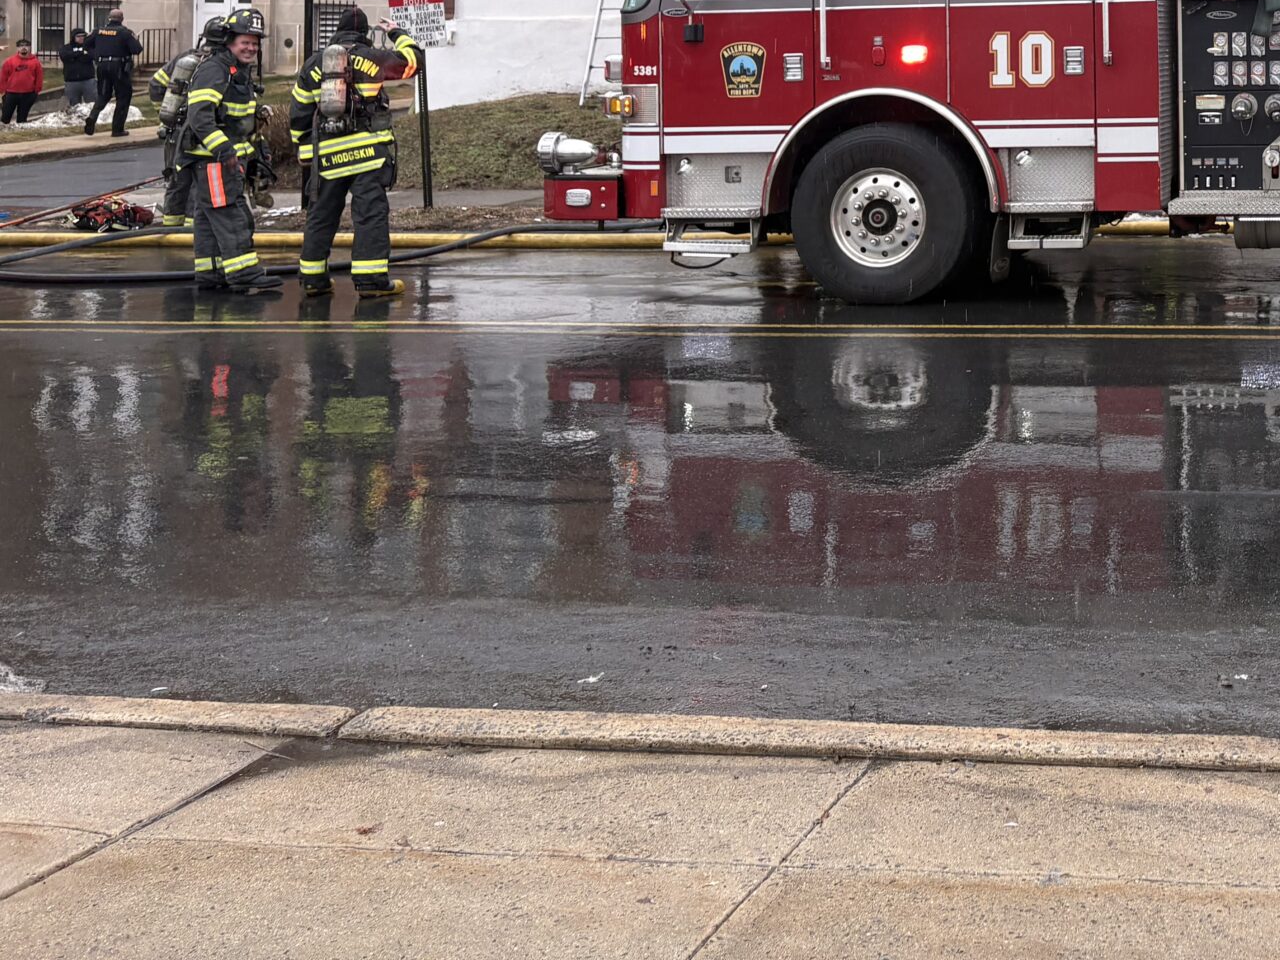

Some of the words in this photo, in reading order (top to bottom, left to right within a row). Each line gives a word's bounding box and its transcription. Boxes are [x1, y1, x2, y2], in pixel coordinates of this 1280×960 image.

[413, 4, 429, 12] TIRES
[391, 13, 412, 21] CHAINS
[416, 10, 443, 20] REQUIRED
[252, 17, 262, 29] 11
[410, 18, 440, 27] PARKING
[415, 25, 445, 34] EMERGENCY
[723, 44, 764, 58] ALLENTOWN
[988, 30, 1055, 88] 10
[633, 65, 657, 76] 5381
[321, 157, 331, 167] K.
